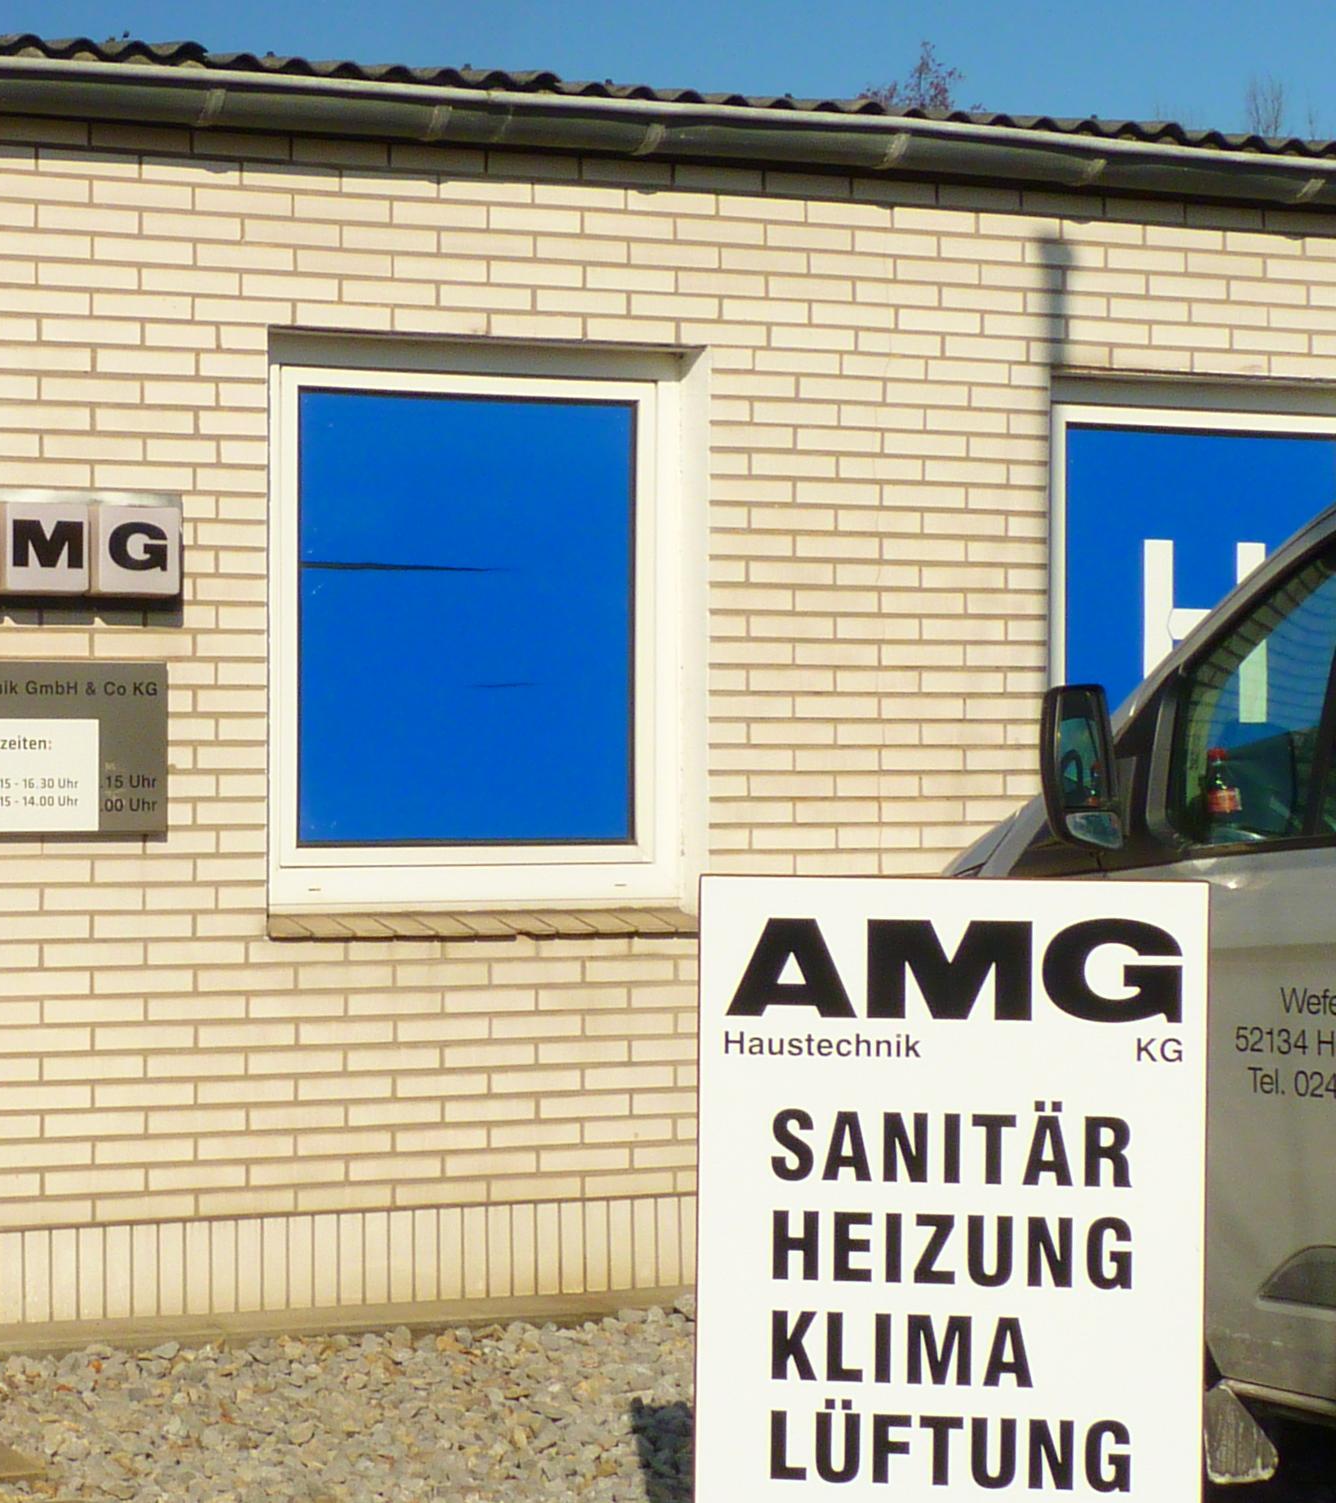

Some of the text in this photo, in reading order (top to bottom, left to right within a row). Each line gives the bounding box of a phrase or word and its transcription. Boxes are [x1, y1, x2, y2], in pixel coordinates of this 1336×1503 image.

[25, 680, 78, 696] GmbH
[85, 682, 96, 696] &
[103, 682, 127, 697] Co
[132, 682, 158, 697] KG
[22, 777, 54, 789] 16.30
[58, 777, 79, 789] Uhr
[129, 774, 157, 789] Uhr
[22, 796, 54, 807] 14.00
[58, 795, 79, 807] Uhr
[129, 798, 157, 812] Uhr
[726, 918, 1183, 1022] AMG
[724, 1031, 1183, 1062] Haustechnik KG
[1235, 1027, 1308, 1055] 52134
[1247, 1067, 1285, 1095] Tel.
[771, 1101, 1132, 1187] SANITÄR
[771, 1210, 1132, 1289] HEIZUNG
[771, 1310, 1033, 1388] KLIMA
[770, 1399, 1131, 1492] LÜFTUNG
